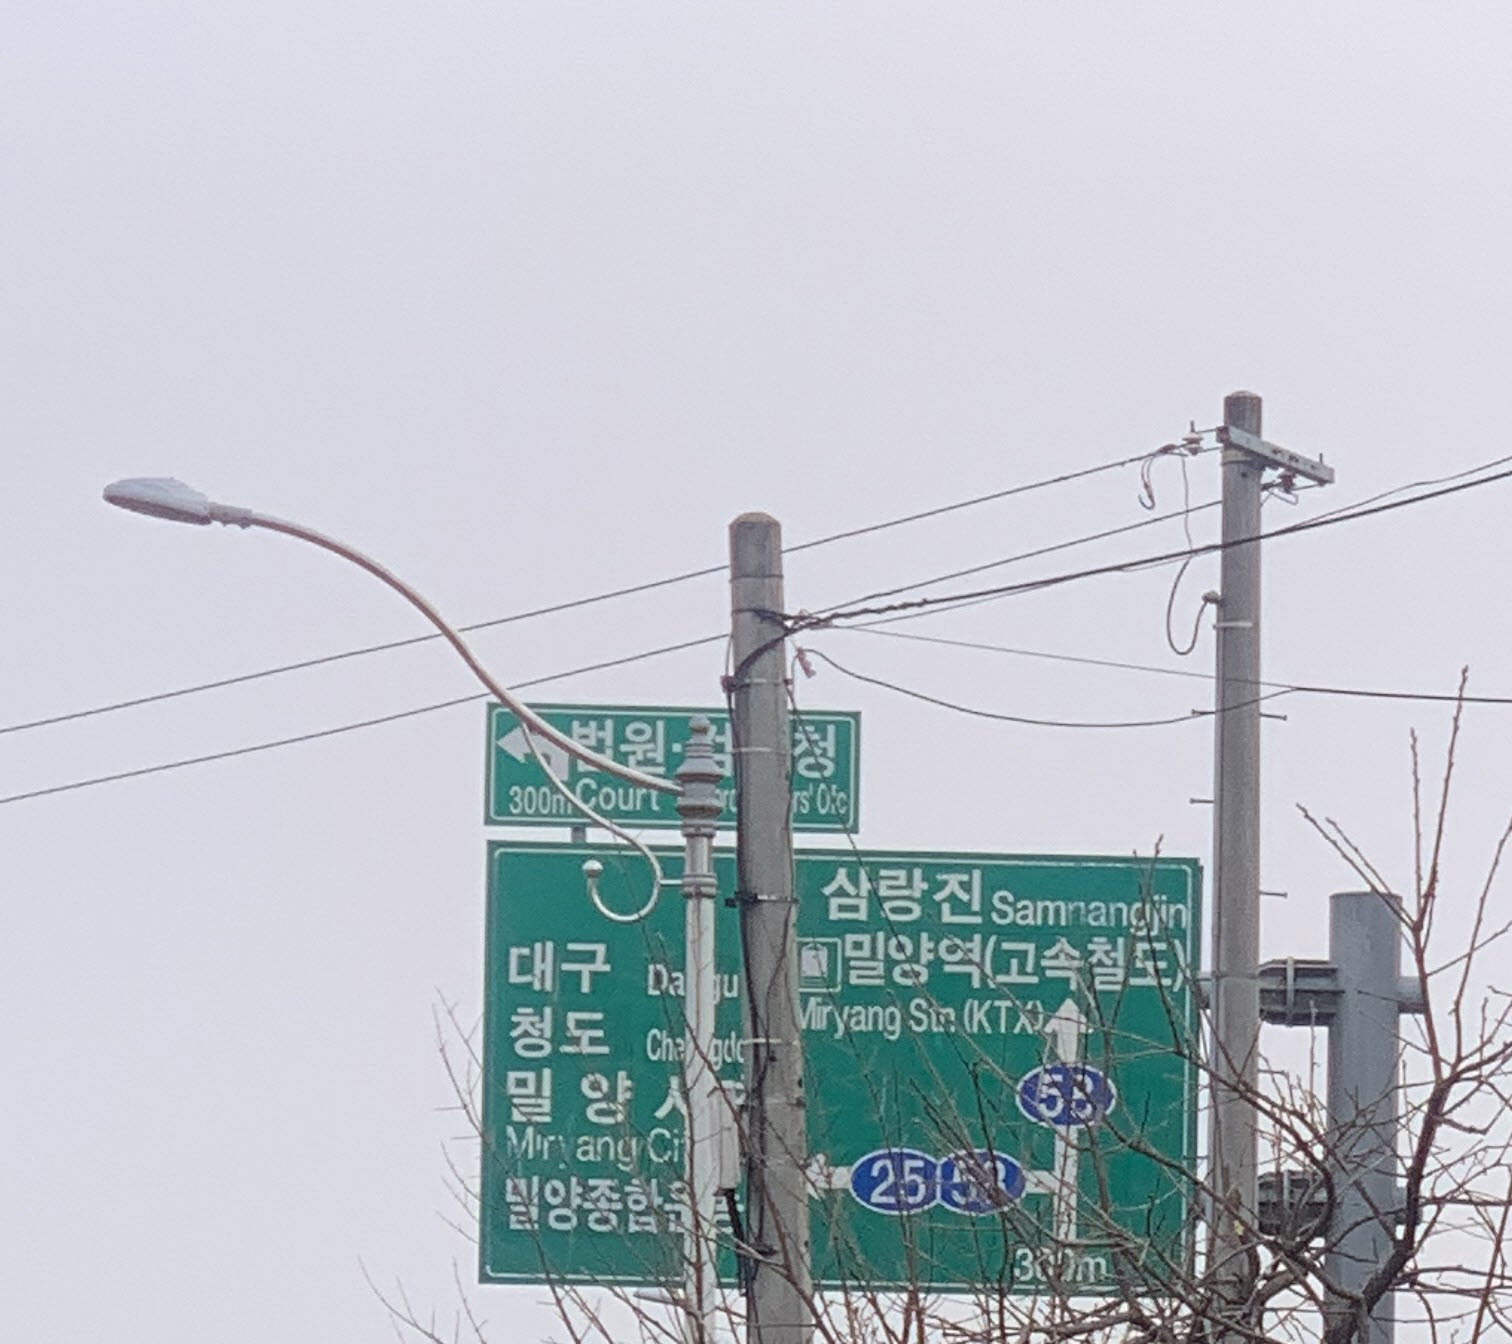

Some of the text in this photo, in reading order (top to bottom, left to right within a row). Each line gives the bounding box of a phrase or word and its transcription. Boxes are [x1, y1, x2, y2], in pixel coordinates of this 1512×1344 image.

[575, 778, 660, 812] Court
[821, 868, 1187, 935] 삼랑진 Samnangjin
[507, 940, 611, 993] 대구
[843, 931, 1187, 993] 밀양역(고속철도)
[509, 1005, 610, 1059] 청도
[870, 1158, 926, 1206] 25
